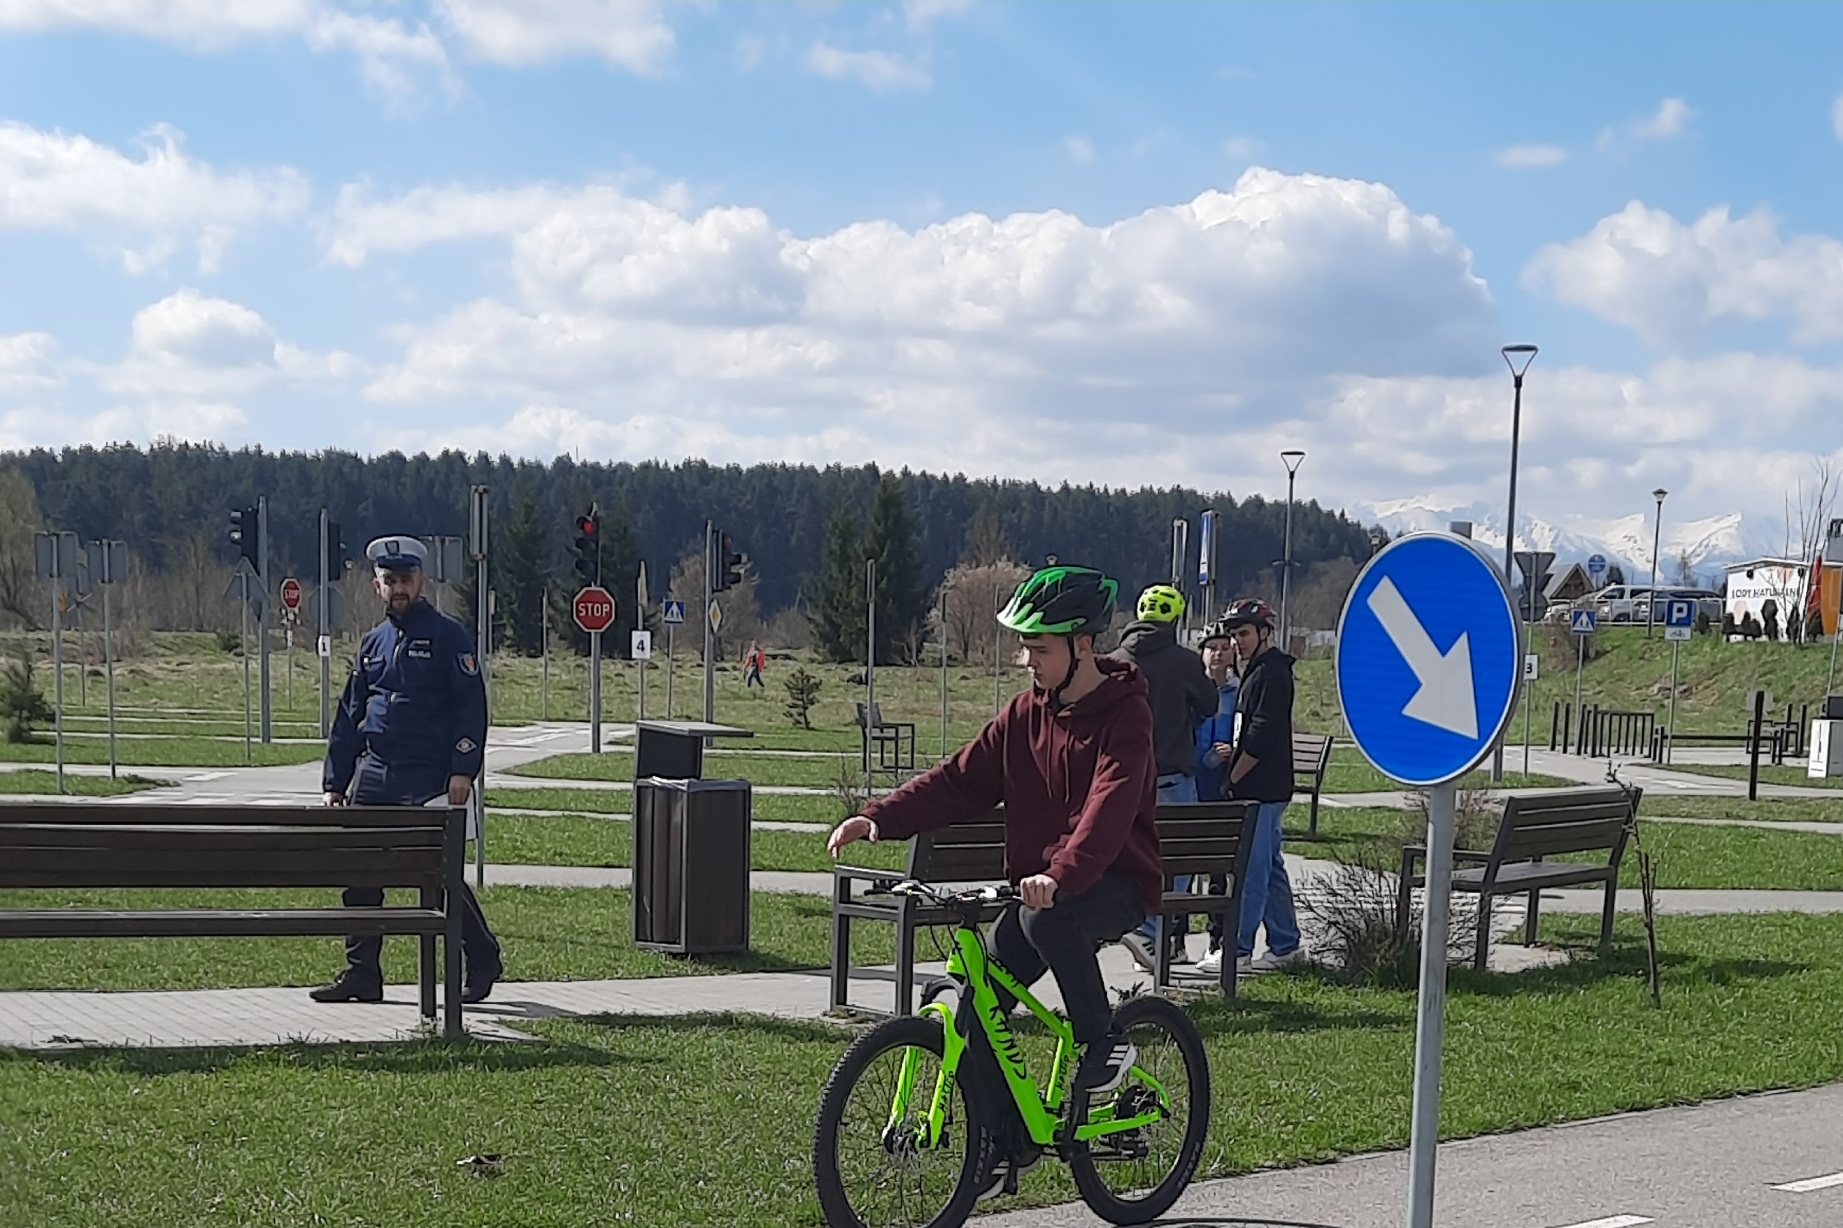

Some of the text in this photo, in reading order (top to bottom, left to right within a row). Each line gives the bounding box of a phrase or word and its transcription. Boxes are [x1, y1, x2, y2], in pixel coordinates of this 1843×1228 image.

[578, 603, 610, 617] STOP
[1671, 603, 1688, 624] P
[321, 641, 328, 653] 1
[636, 639, 645, 653] 4
[1525, 662, 1533, 674] 3
